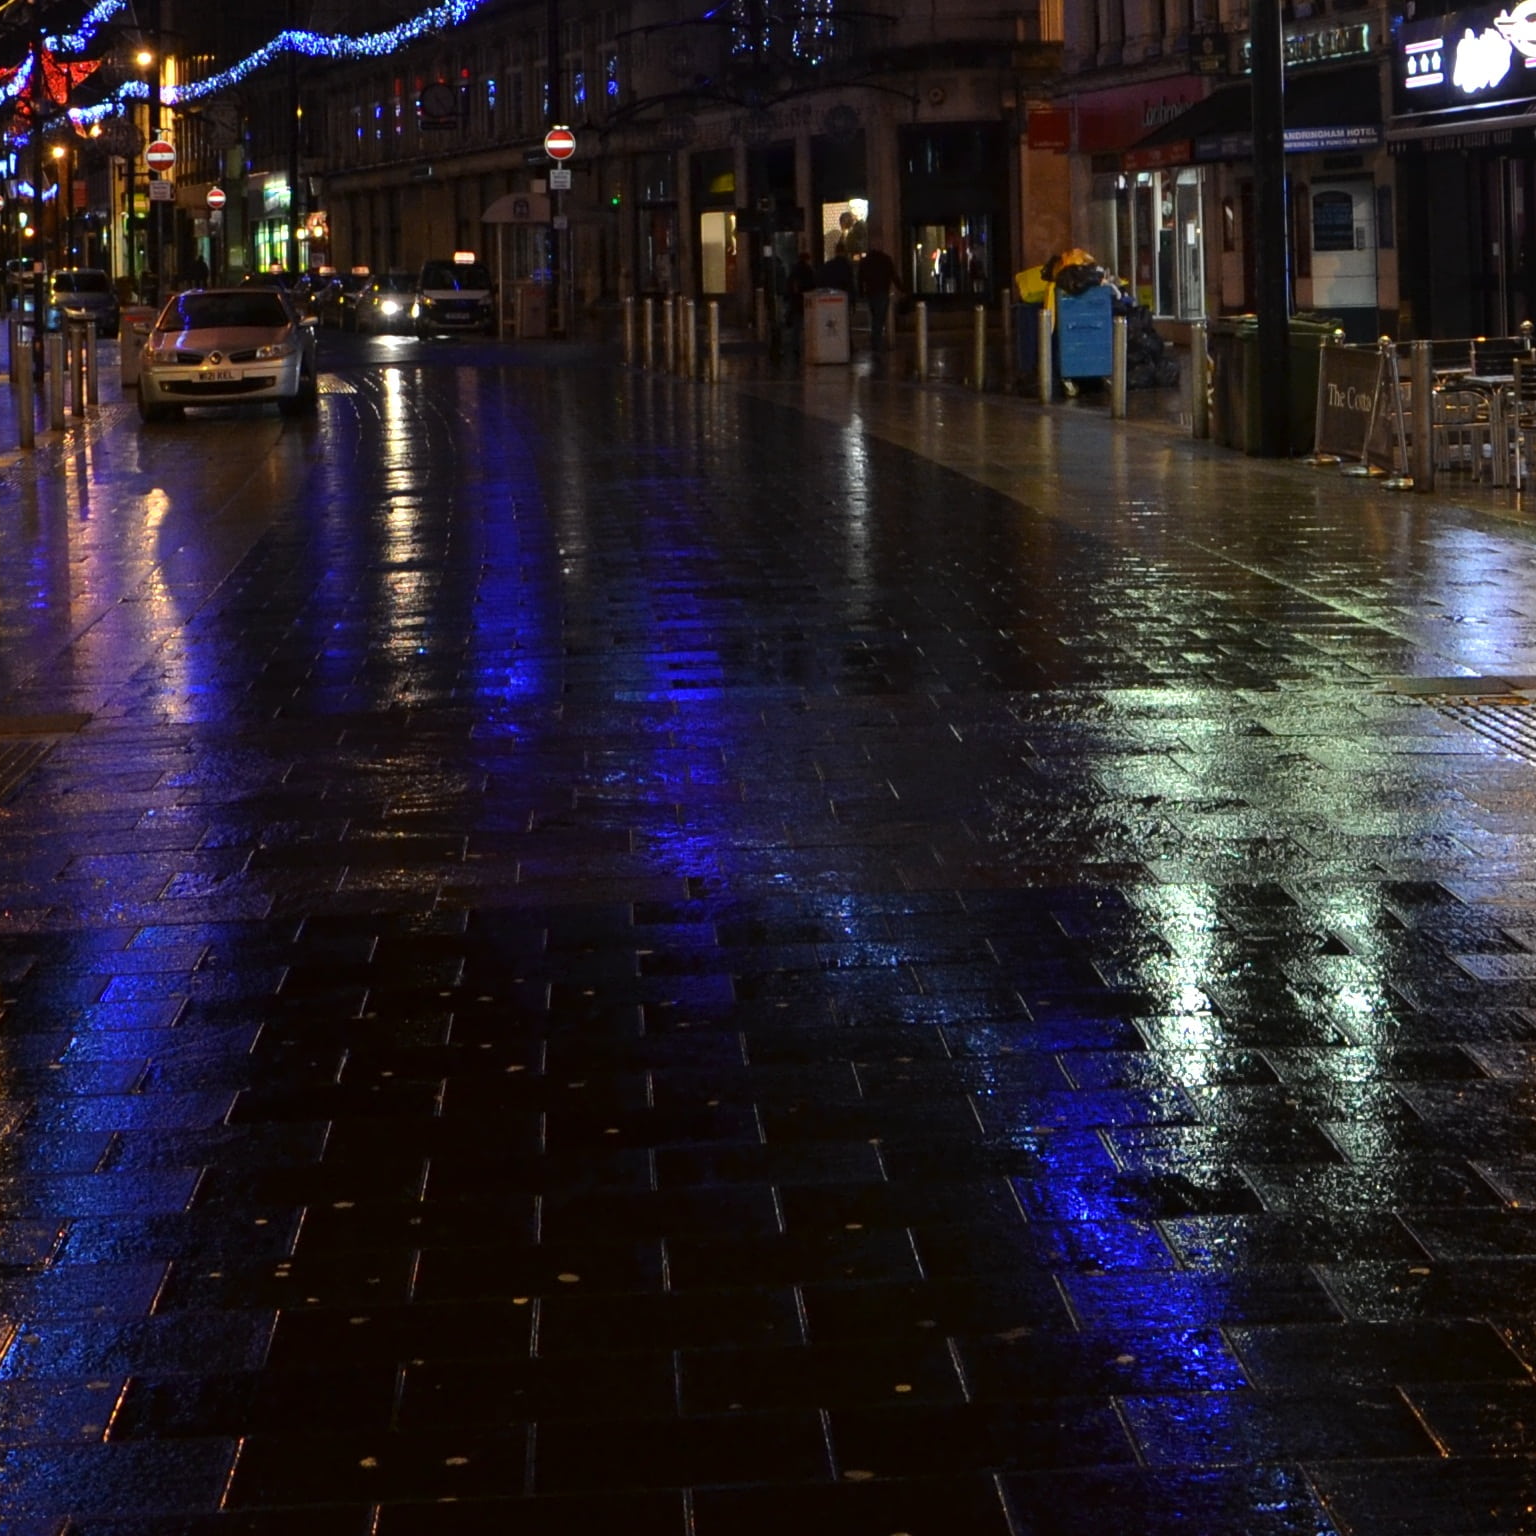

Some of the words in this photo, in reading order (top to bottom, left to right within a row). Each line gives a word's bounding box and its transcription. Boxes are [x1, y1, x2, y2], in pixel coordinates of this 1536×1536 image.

[1284, 129, 1345, 141] ANDRINGHAM
[1347, 127, 1377, 138] HOTEL
[1328, 381, 1346, 408] The
